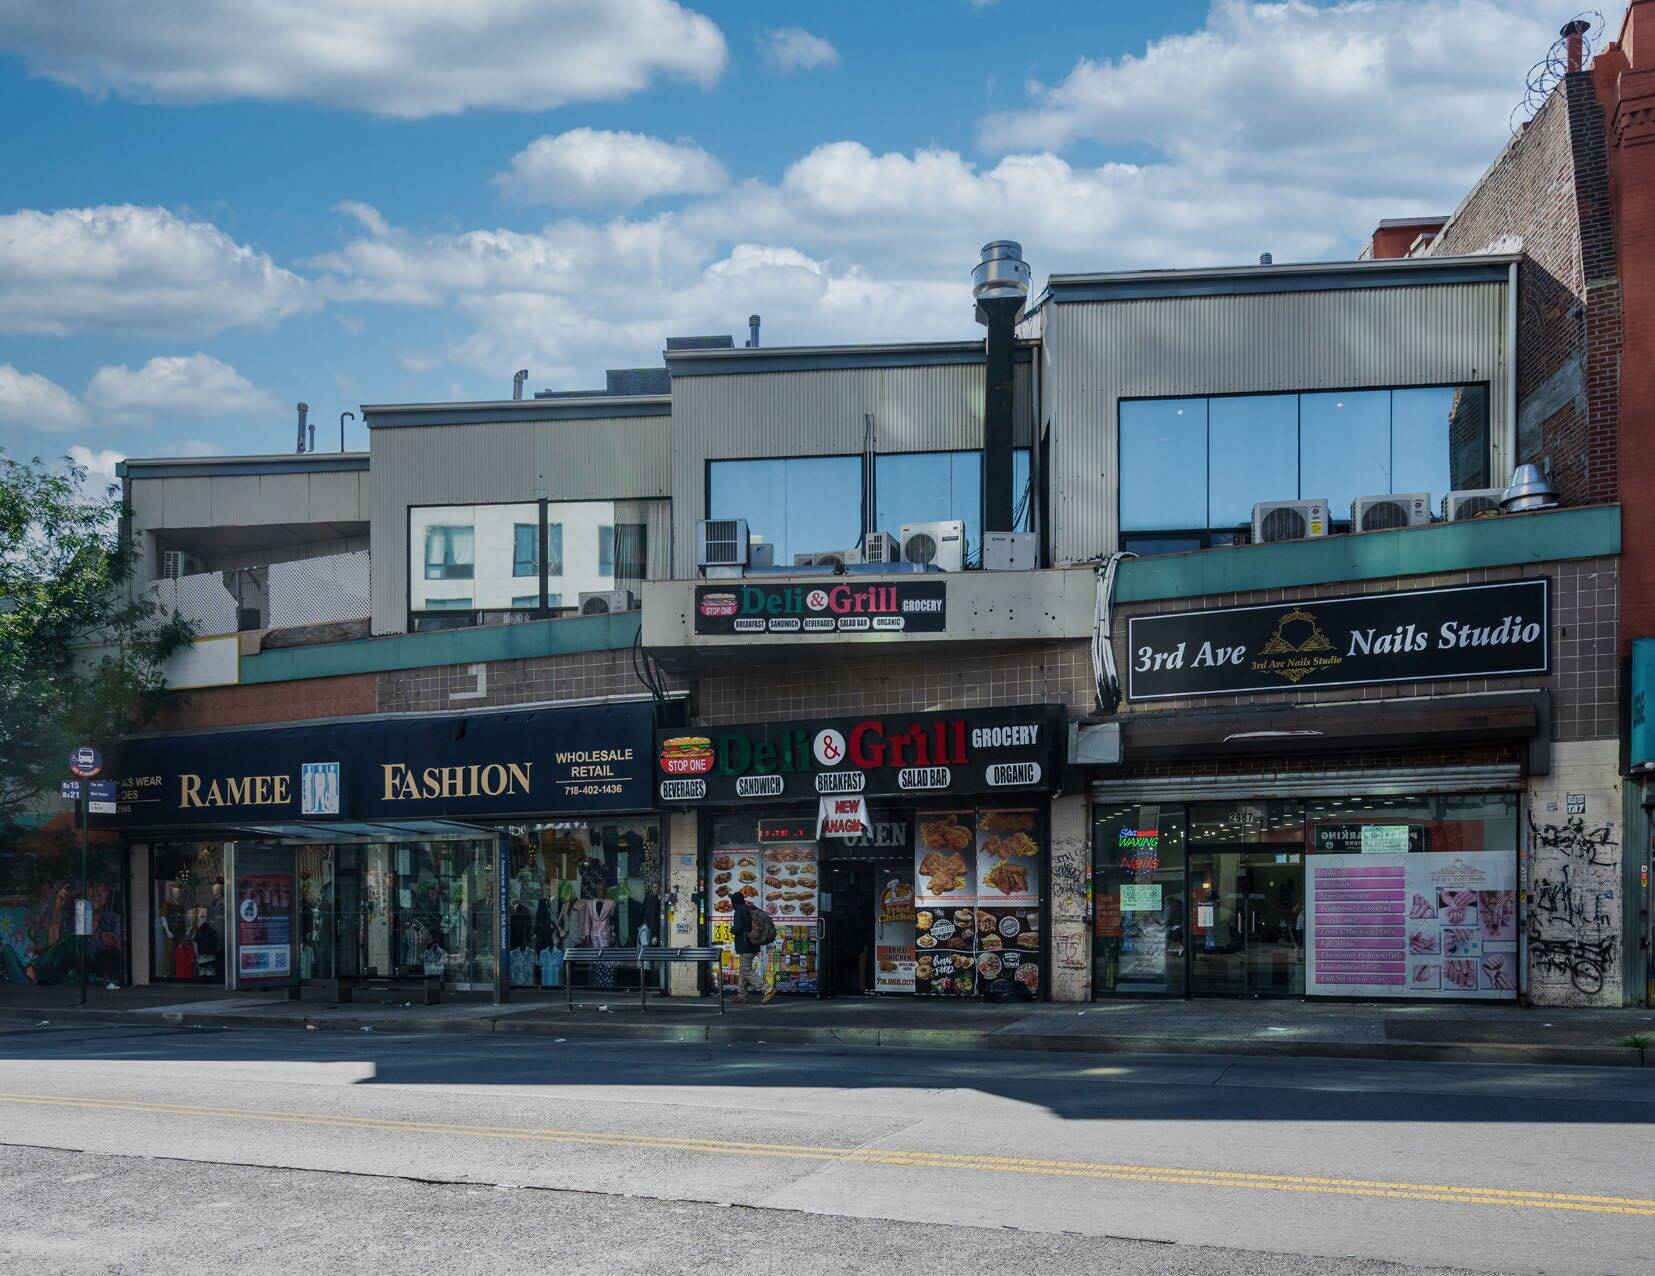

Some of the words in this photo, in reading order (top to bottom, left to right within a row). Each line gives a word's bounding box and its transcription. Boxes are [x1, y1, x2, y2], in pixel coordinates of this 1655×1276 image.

[739, 585, 804, 615] Deli
[809, 592, 825, 607] &
[828, 583, 899, 614] Grill
[902, 599, 942, 612] GROCERY
[705, 607, 721, 615] STOP
[721, 606, 732, 615] ONE
[735, 619, 764, 628] BREAKFAST
[770, 619, 799, 628] SANDWICH
[804, 619, 834, 628] BEVERAGES
[839, 618, 855, 627] SALAD
[856, 618, 868, 627] BAR
[876, 617, 901, 626] ORGANIC
[1347, 624, 1428, 657] Nails
[1437, 615, 1541, 649] Studio
[1134, 644, 1185, 672] 3rd
[1191, 640, 1246, 668] Ave
[1251, 660, 1268, 670] 3rd
[1269, 659, 1285, 669] Ave
[1287, 657, 1309, 668] Nails
[1310, 655, 1343, 667] Studio
[971, 724, 1039, 749] GROCERY
[717, 730, 815, 777] Deli
[823, 734, 841, 761] &
[848, 720, 970, 769] Grill
[555, 749, 633, 764] WHOLESALE
[571, 765, 614, 778] RETAIL
[668, 759, 688, 771] STOP
[689, 758, 706, 771] ONE
[135, 775, 162, 787] WEAR
[381, 762, 533, 800] FASHION
[901, 769, 925, 788] SALAD
[927, 768, 948, 787] BAR
[994, 765, 1034, 783] ORGANIC
[739, 777, 781, 796] SANDWICH
[817, 772, 864, 791] BREAKFAST
[178, 773, 292, 808] RAMEE
[564, 784, 622, 795] 718-402-1436
[663, 781, 706, 799] BEVERAGES
[835, 799, 860, 814] NEW
[821, 819, 861, 833] ANAGM
[1119, 837, 1159, 848] WAXING
[1120, 856, 1160, 869] Nails
[884, 953, 912, 961] CHICKEN
[888, 946, 907, 954] FRIED
